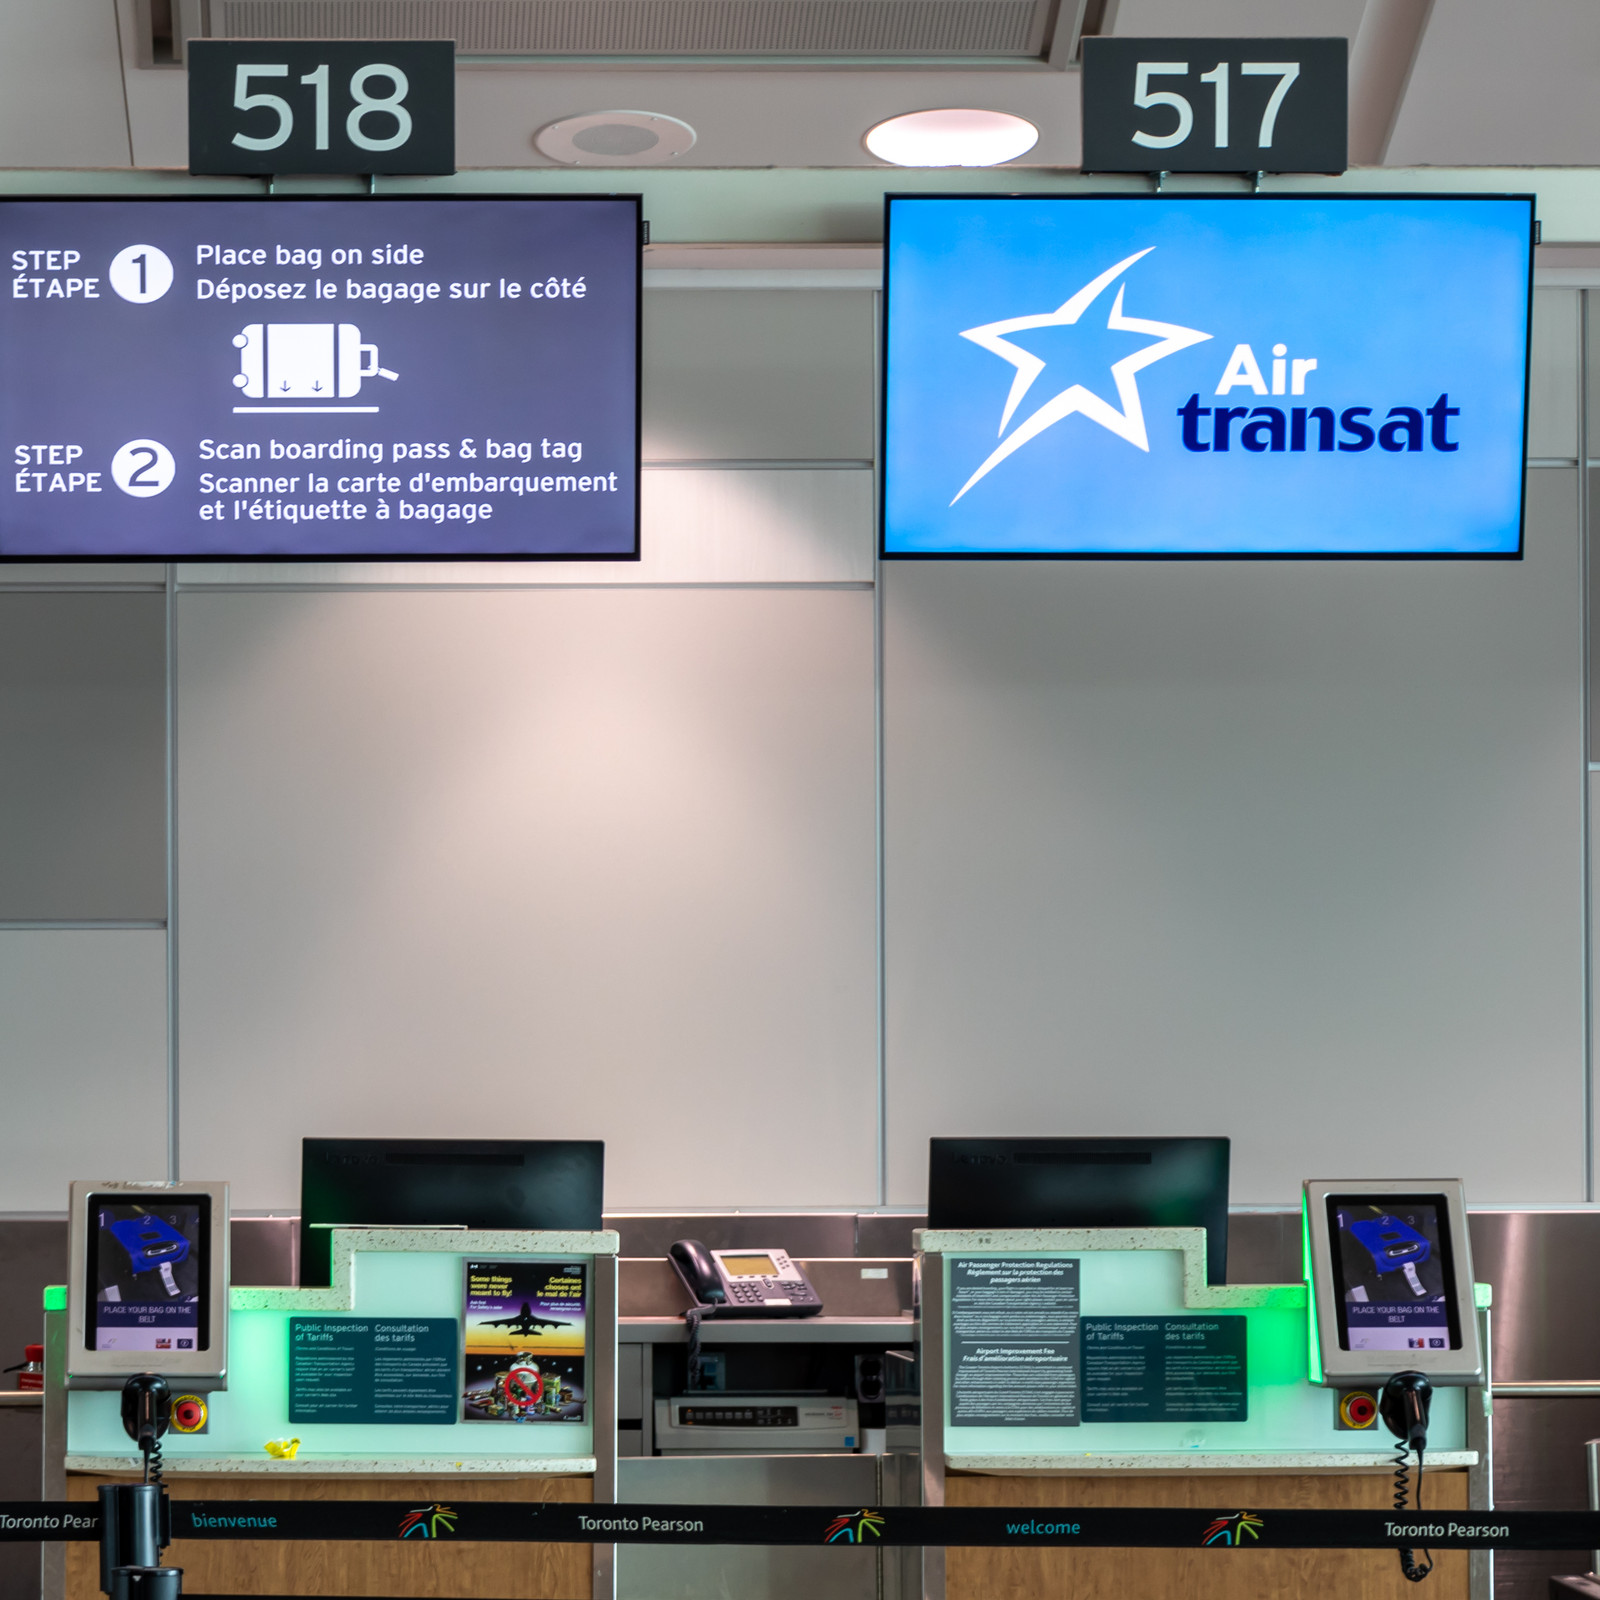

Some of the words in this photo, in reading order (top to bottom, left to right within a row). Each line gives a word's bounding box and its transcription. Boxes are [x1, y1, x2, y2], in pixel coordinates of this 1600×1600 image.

[231, 63, 412, 152] 518
[1131, 61, 1301, 149] 517
[11, 250, 81, 271] STEP
[196, 244, 267, 265] Place
[276, 244, 322, 270] bag
[331, 248, 363, 265] on
[371, 243, 424, 265] side
[130, 252, 148, 295] 1
[12, 274, 100, 300] ÉTAPE
[197, 277, 307, 304] Déposez
[315, 278, 338, 300] le
[346, 278, 441, 304] bagage
[449, 282, 492, 299] sur
[499, 278, 522, 299] le
[530, 276, 587, 299] côté
[1215, 343, 1318, 396] Air
[1176, 392, 1461, 453] transat
[14, 444, 83, 466] STEP
[199, 438, 261, 460] Scan
[270, 438, 384, 464] boarding
[392, 442, 451, 464] pass
[459, 438, 478, 459] &
[486, 438, 532, 464] bag
[540, 437, 582, 463] tag
[127, 446, 160, 488] 2
[15, 469, 103, 493] ÉTAPE
[199, 472, 301, 494] Scanner
[308, 472, 329, 494] la
[337, 472, 402, 493] carte
[409, 471, 618, 497] d'embarquement
[199, 500, 225, 521] et
[234, 498, 368, 524] l'étiquette
[375, 497, 390, 520] à
[399, 499, 493, 524] bagage
[98, 1212, 105, 1228] 1
[143, 1215, 152, 1225] 2
[169, 1215, 177, 1225] 3
[1337, 1213, 1344, 1228] 1
[1381, 1215, 1390, 1225] 2
[1407, 1215, 1415, 1225] 3
[1018, 1269, 1052, 1277] protection
[1036, 1262, 1073, 1270] Regulations
[104, 1306, 127, 1314] PLACE
[128, 1306, 147, 1314] YOUR
[148, 1306, 164, 1314] BAG
[166, 1306, 176, 1314] ON
[178, 1306, 191, 1314] THE
[1352, 1306, 1375, 1314] PLACE
[1377, 1306, 1396, 1314] YOUR
[1397, 1306, 1412, 1314] BAG
[1414, 1306, 1425, 1314] ON
[1426, 1306, 1440, 1314] THE
[138, 1315, 156, 1323] BELT
[1165, 1322, 1219, 1330] Consultation
[1388, 1315, 1405, 1323] BELT
[295, 1323, 321, 1332] Public
[324, 1324, 369, 1333] Inspection
[374, 1324, 429, 1332] Consultation
[1086, 1323, 1112, 1331] Public
[1114, 1323, 1159, 1332] Inspection
[295, 1333, 304, 1341] of
[307, 1333, 334, 1341] Tariffs
[374, 1334, 390, 1342] des
[392, 1334, 415, 1342] tarifs
[1086, 1332, 1095, 1340] of
[1097, 1332, 1124, 1340] Tariffs
[1182, 1332, 1205, 1340] tarifs
[976, 1348, 999, 1356] Airport
[1000, 1348, 1042, 1356] Improvement
[0, 1514, 60, 1529] Toronto
[63, 1514, 99, 1529] Pear
[191, 1512, 278, 1529] bienvenue
[578, 1515, 639, 1532] Toronto
[642, 1516, 704, 1532] Pearson
[1006, 1519, 1081, 1535] welcome
[1384, 1521, 1445, 1537] Toronto
[1447, 1522, 1510, 1538] Pearson
